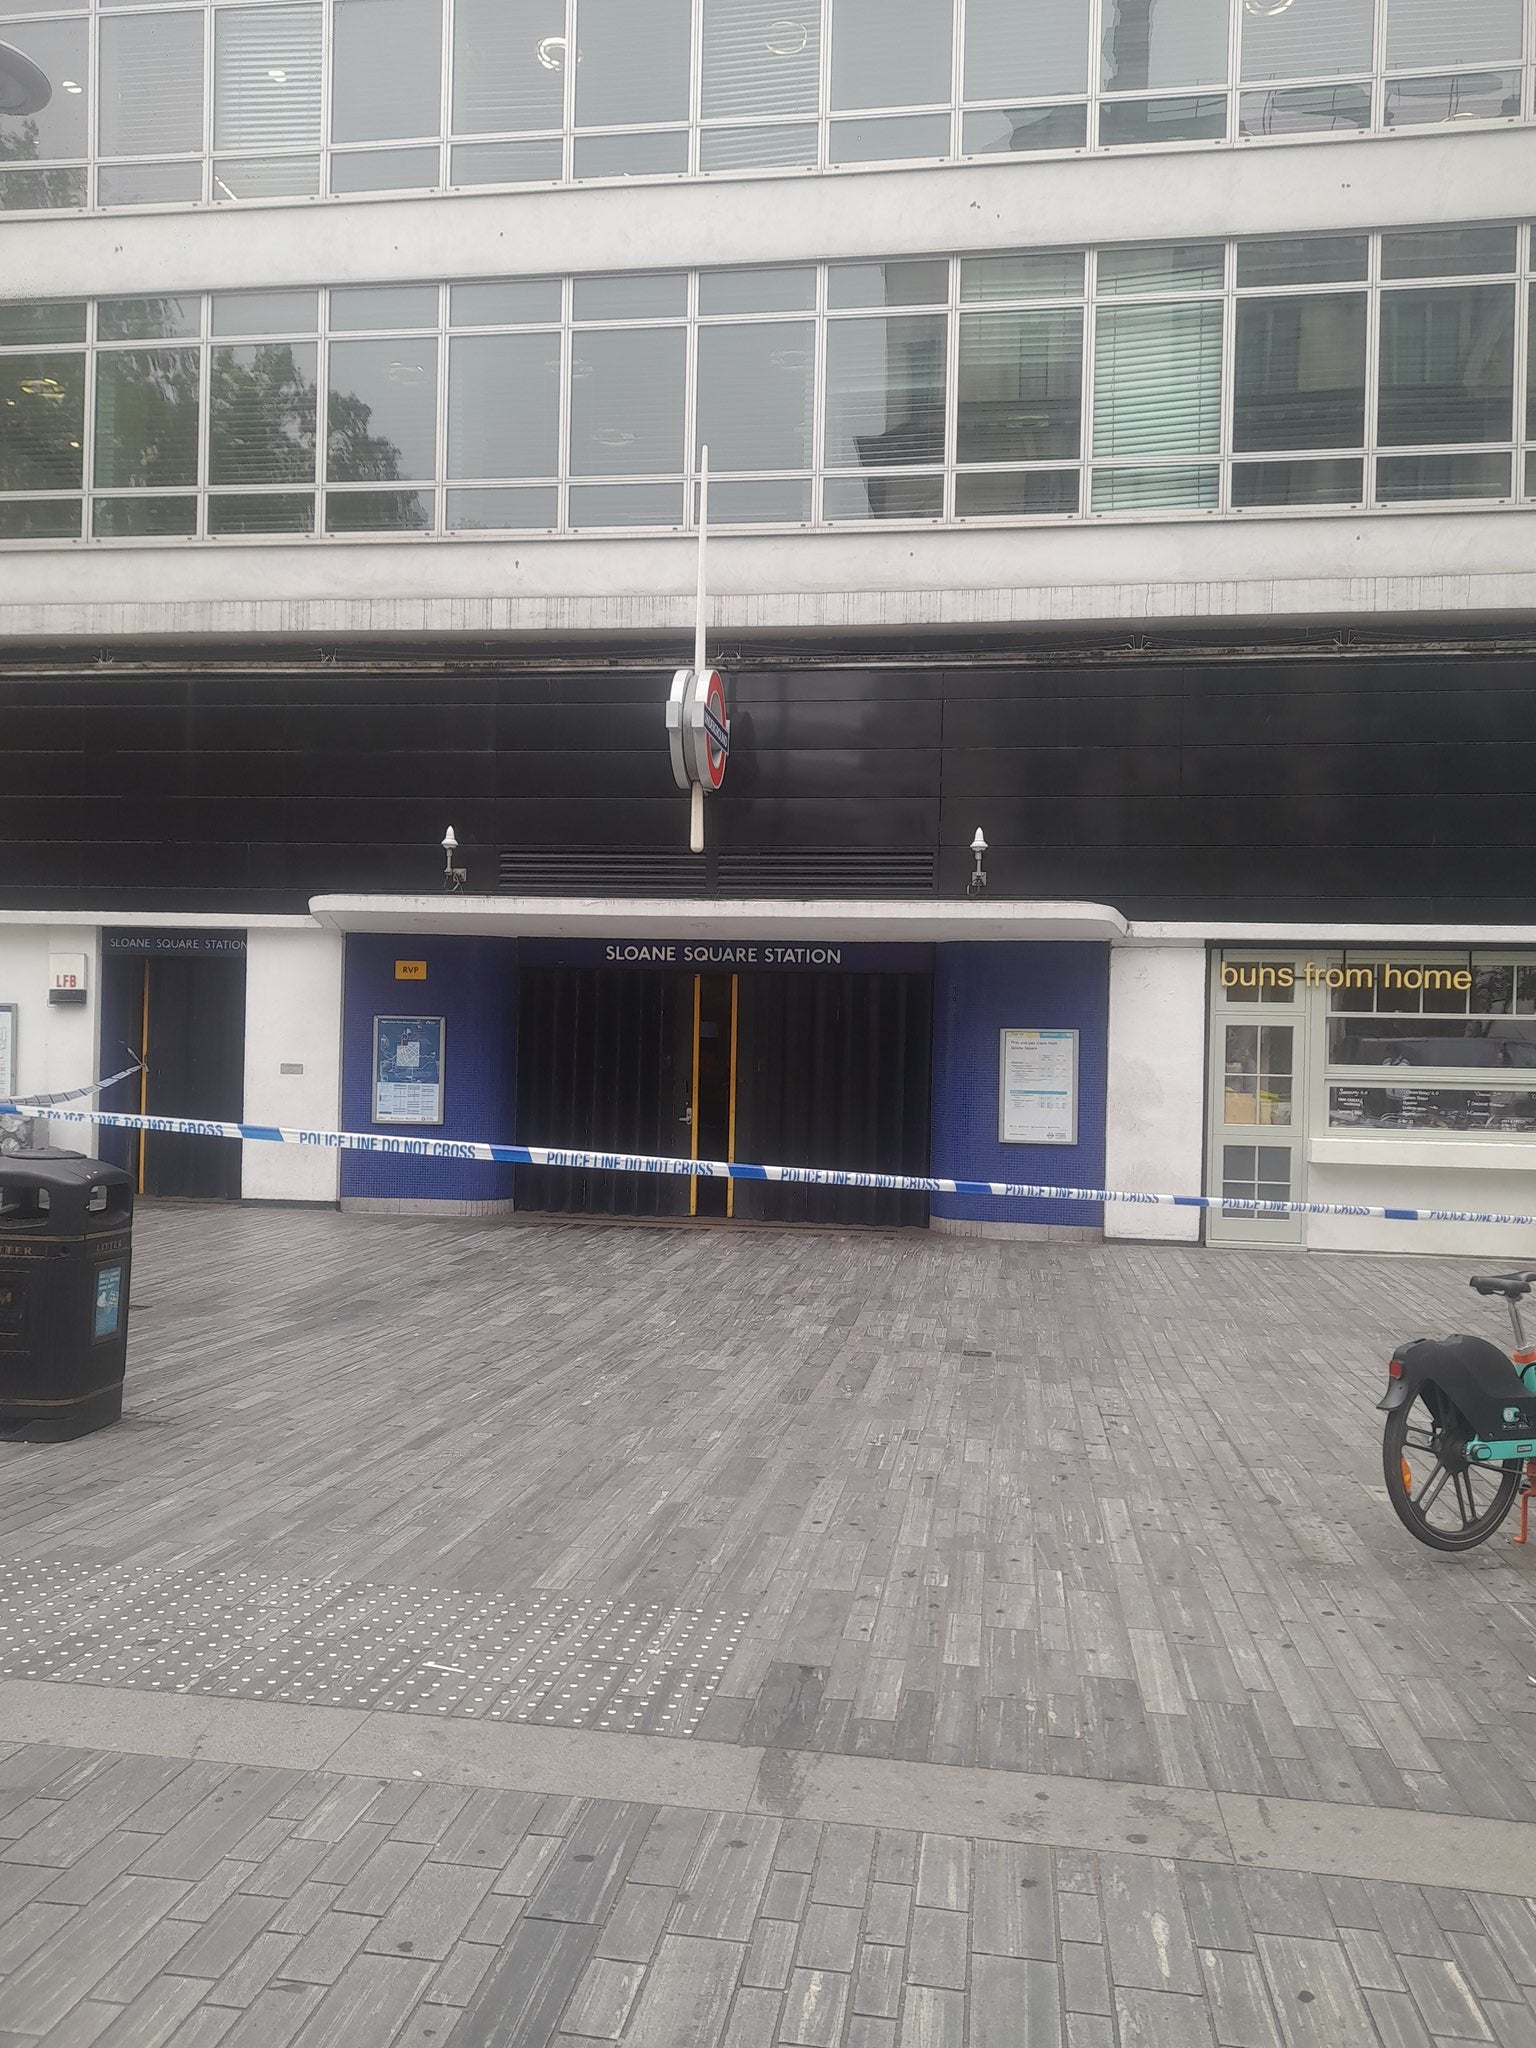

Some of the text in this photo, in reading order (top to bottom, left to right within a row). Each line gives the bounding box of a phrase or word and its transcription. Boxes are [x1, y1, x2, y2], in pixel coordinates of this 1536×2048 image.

[110, 938, 150, 948] SLOANE
[156, 938, 199, 949] SQUARE
[606, 945, 841, 964] SLOANE SQUARE STATION
[402, 966, 419, 974] RVP
[1221, 961, 1472, 990] buns from home
[56, 974, 77, 988] LFB
[299, 1132, 476, 1158] POLICE LINE DO NOT CROSS
[546, 1151, 714, 1176] POLICE LINE DO NOT CROSS
[780, 1167, 941, 1191] POLICE LINE DO NOT CROSS
